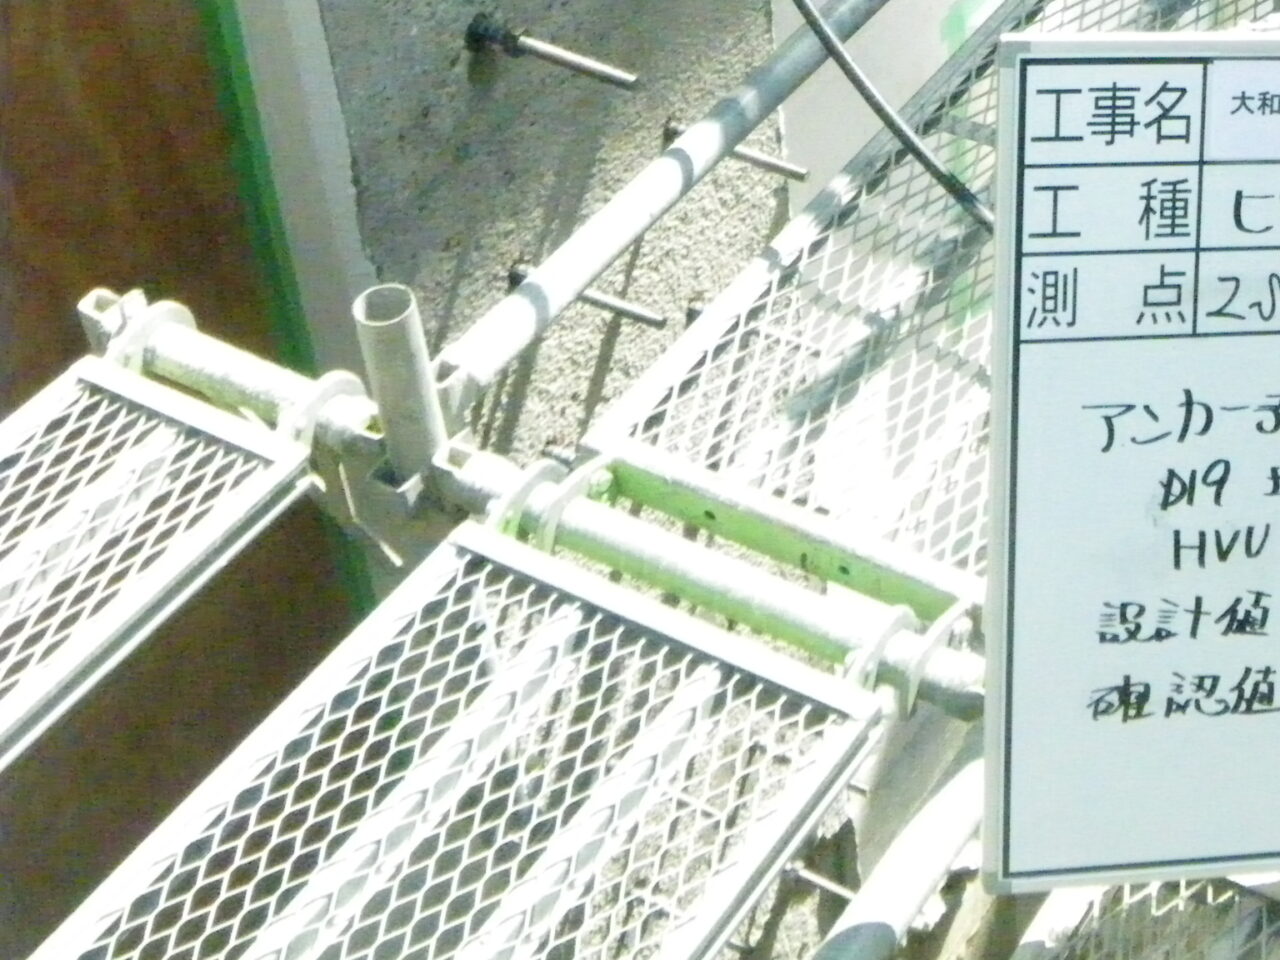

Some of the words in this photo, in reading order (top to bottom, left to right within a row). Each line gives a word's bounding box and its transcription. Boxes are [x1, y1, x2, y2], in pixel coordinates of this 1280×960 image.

[1030, 80, 1192, 145] 工事名
[1097, 590, 1273, 644] 設計値
